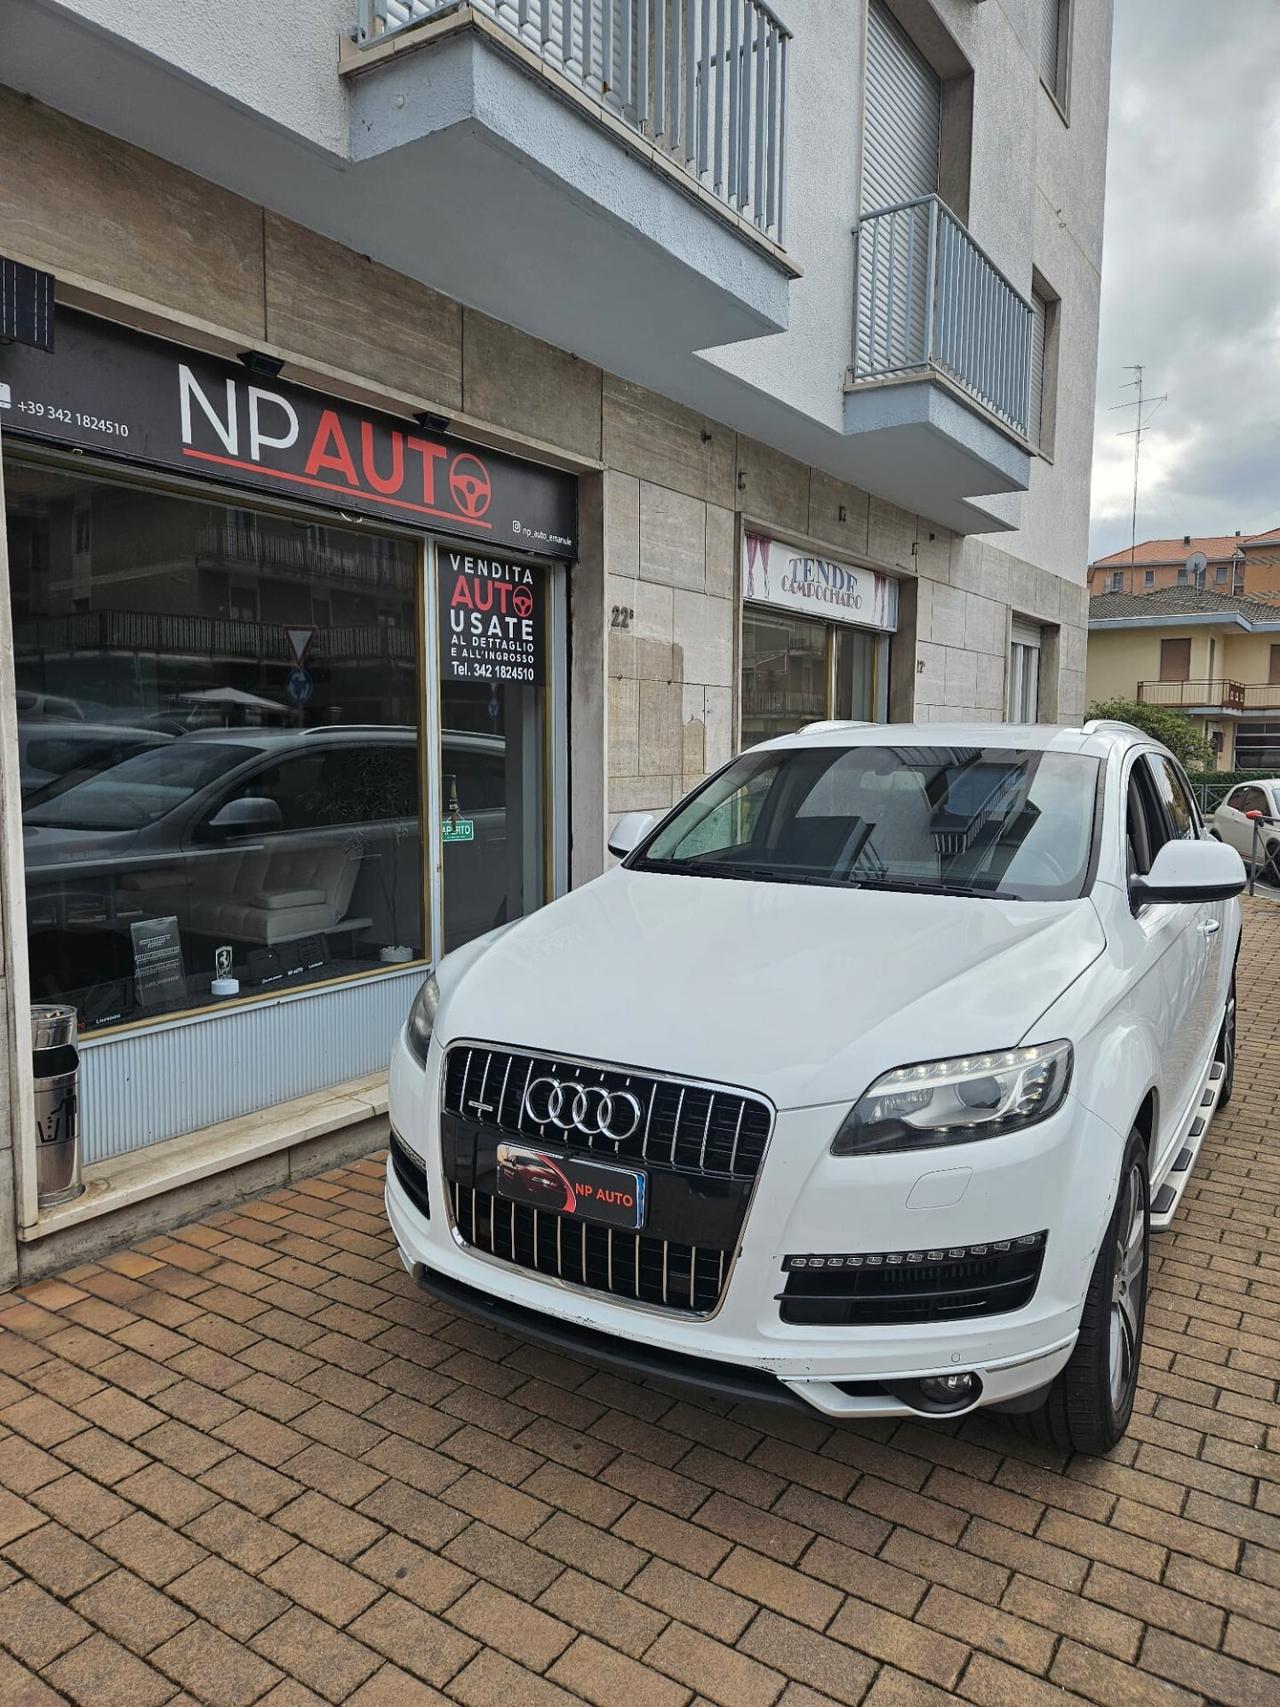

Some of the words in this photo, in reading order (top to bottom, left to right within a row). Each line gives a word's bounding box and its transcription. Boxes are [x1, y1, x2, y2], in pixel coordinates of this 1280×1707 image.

[18, 401, 45, 416] +39
[48, 406, 72, 424] 342
[76, 413, 129, 437] 1824510
[449, 554, 534, 585] VENDITA
[450, 575, 534, 617] AUTO
[450, 609, 534, 641] USATE
[451, 634, 466, 645] AL
[472, 636, 534, 653] DETTAGLIO
[451, 647, 457, 657] E
[461, 648, 534, 663] ALL'INGROSSO
[452, 661, 471, 676] Tel.
[474, 663, 492, 677] 342
[495, 665, 534, 681] 1824510
[575, 1183, 593, 1197] NP
[596, 1188, 633, 1207] AUTO
